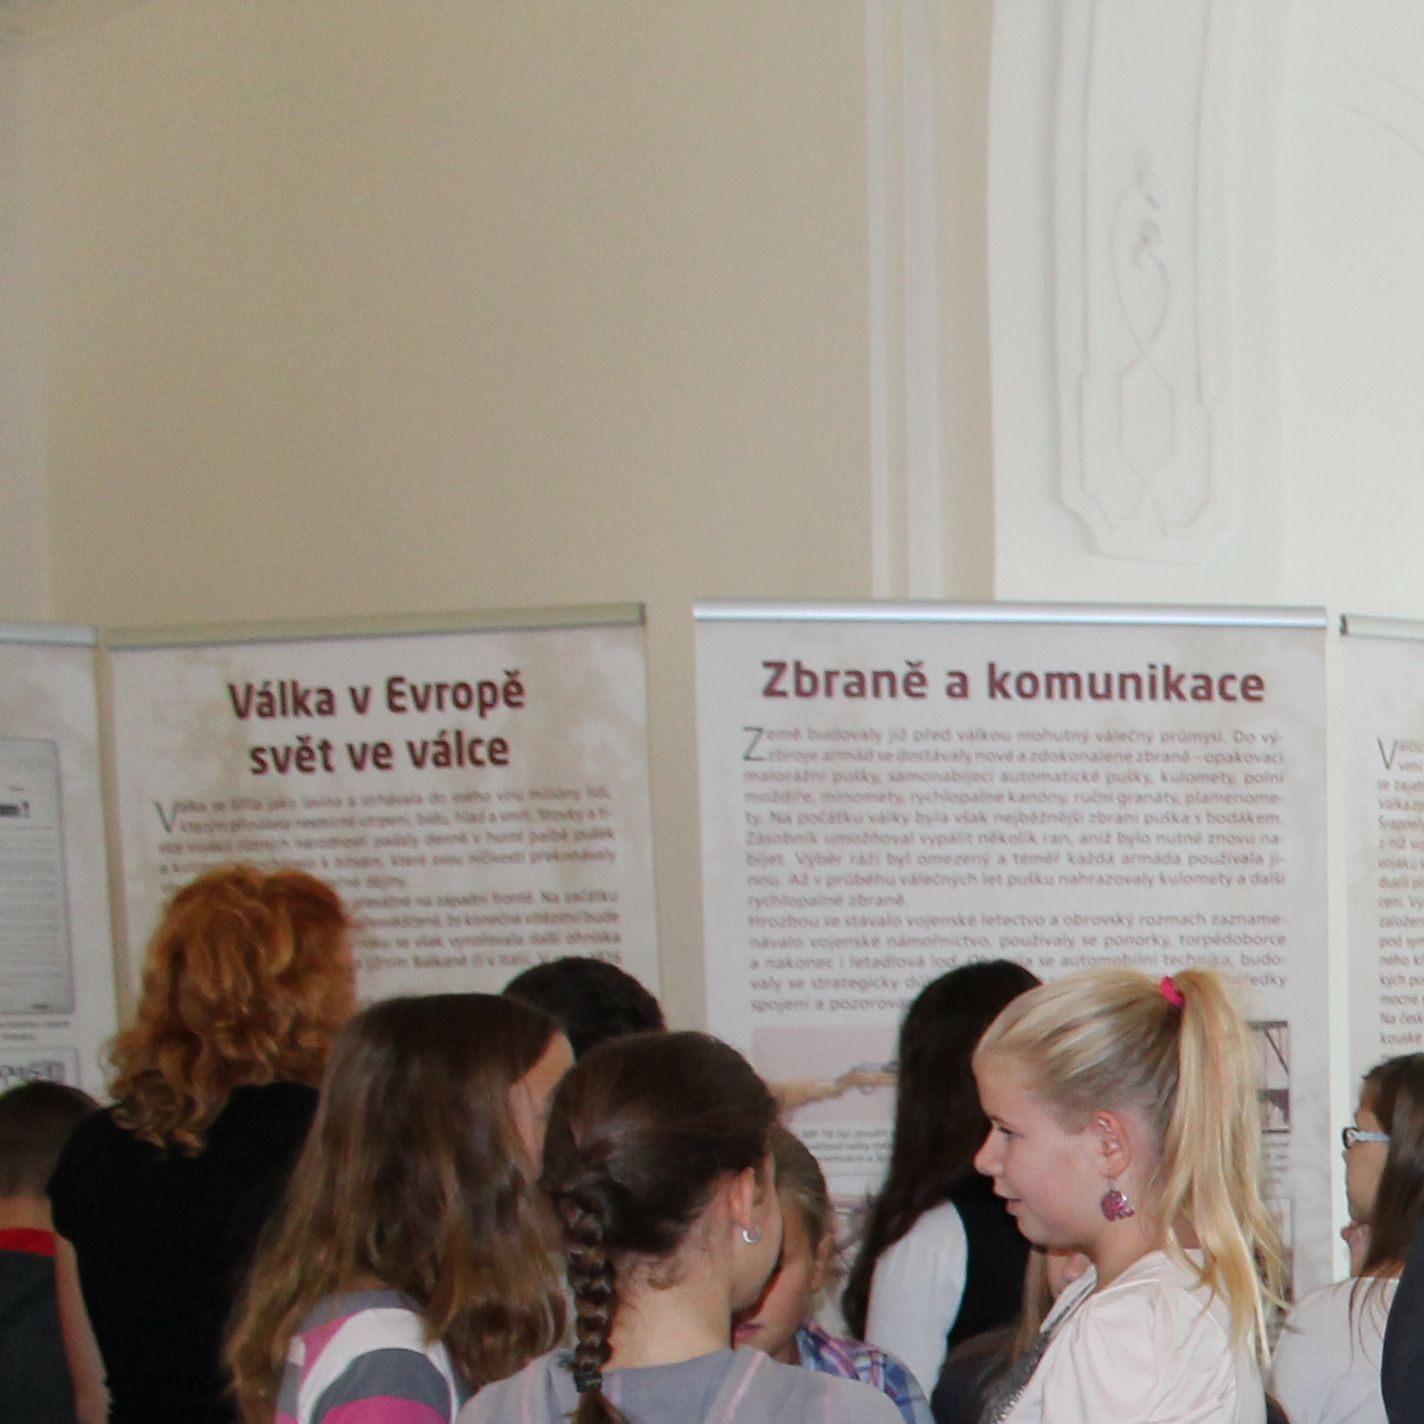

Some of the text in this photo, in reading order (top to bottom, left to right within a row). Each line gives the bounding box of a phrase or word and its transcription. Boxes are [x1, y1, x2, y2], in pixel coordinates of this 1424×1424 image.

[226, 669, 526, 720] Válka v Evropě
[762, 660, 1265, 703] Zbraně a komunikace
[248, 729, 510, 776] svět ve válce
